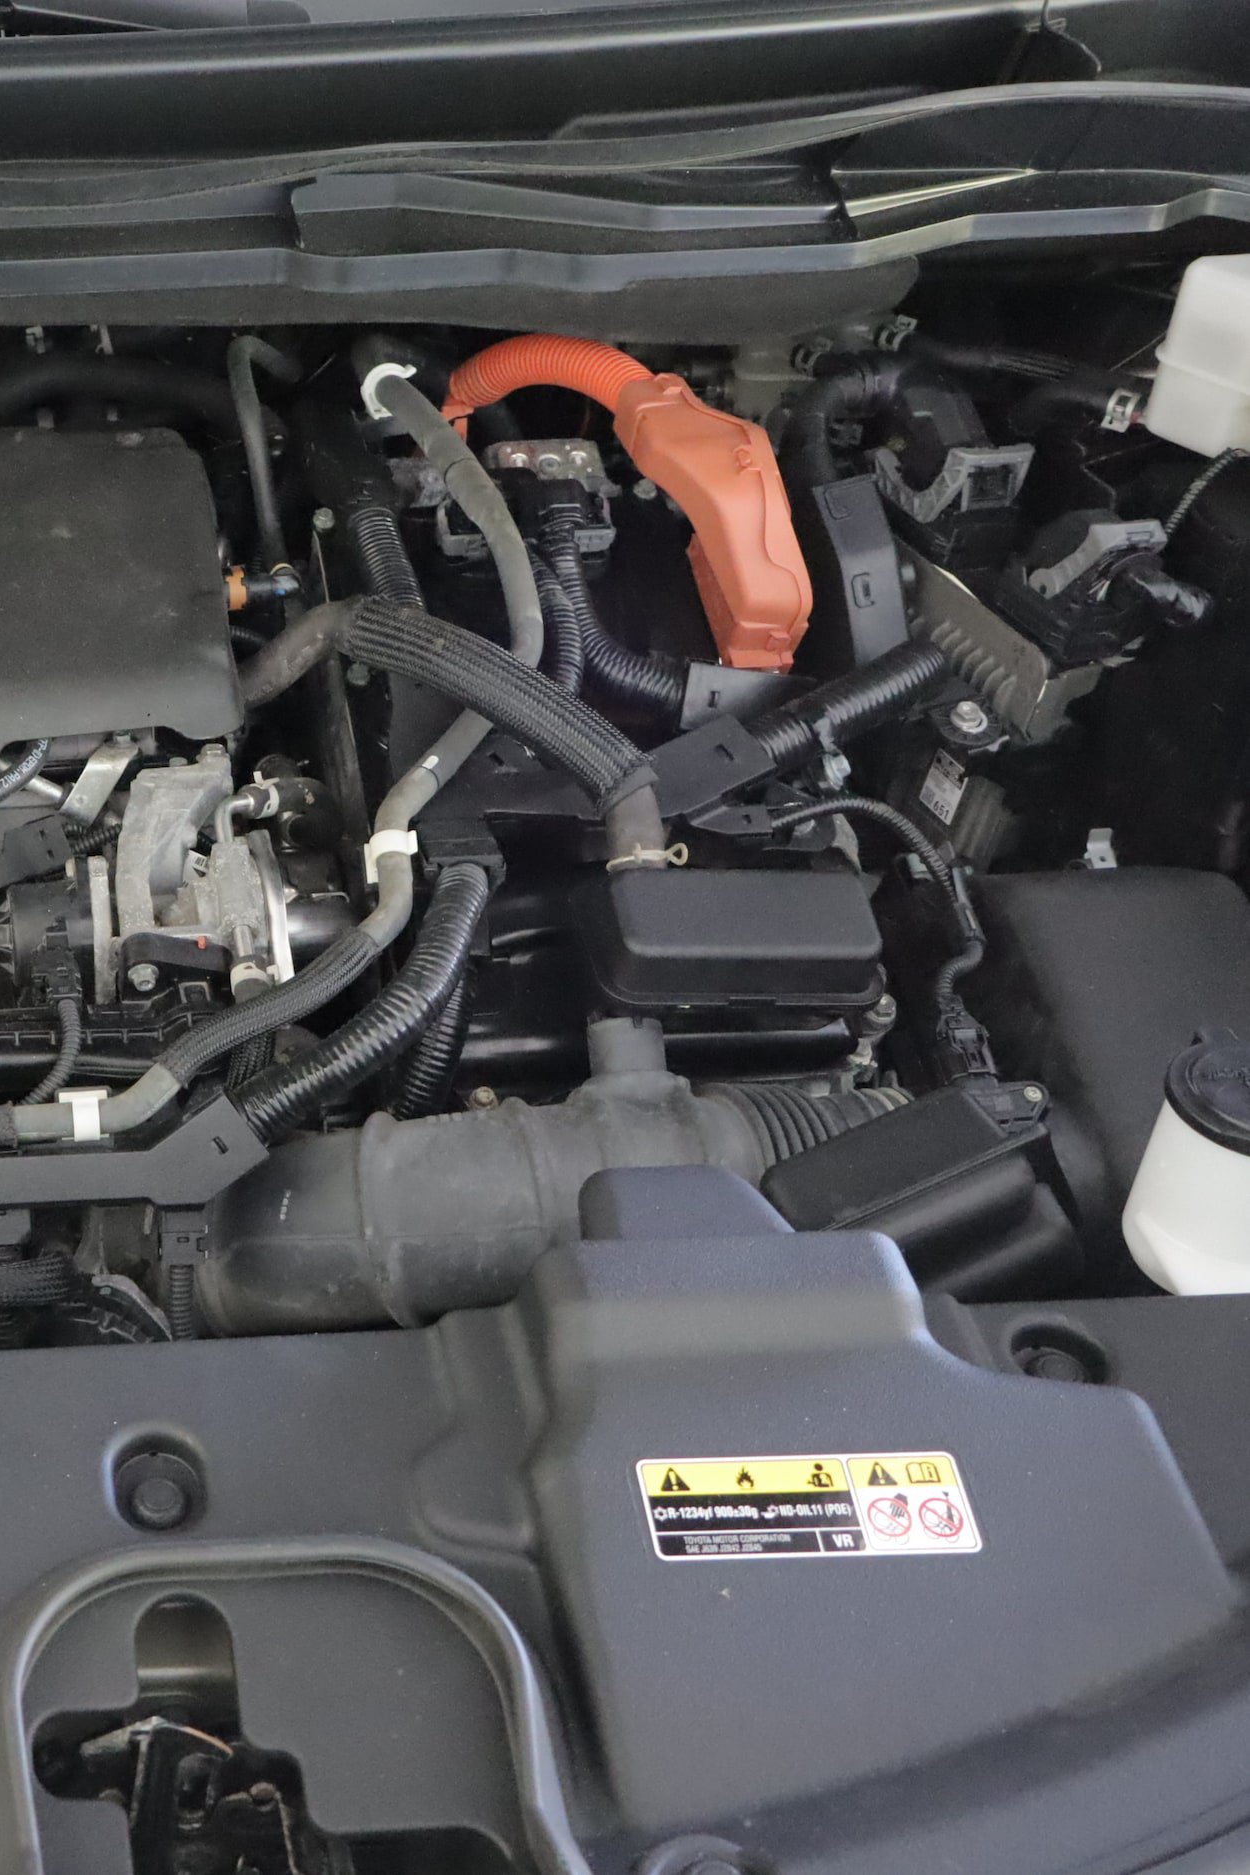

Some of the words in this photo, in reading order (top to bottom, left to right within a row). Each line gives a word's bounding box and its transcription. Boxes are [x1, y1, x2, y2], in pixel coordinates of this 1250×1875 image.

[933, 801, 949, 820] 651
[667, 1506, 713, 1520] R-1234yf
[779, 1503, 823, 1517] ND-OIL11
[825, 1503, 851, 1518] (POE)
[683, 1535, 712, 1545] TOYOTA
[712, 1534, 739, 1544] MOTOR
[740, 1533, 792, 1543] CORPORATION
[832, 1533, 855, 1548] VR
[686, 1544, 701, 1554] SAE
